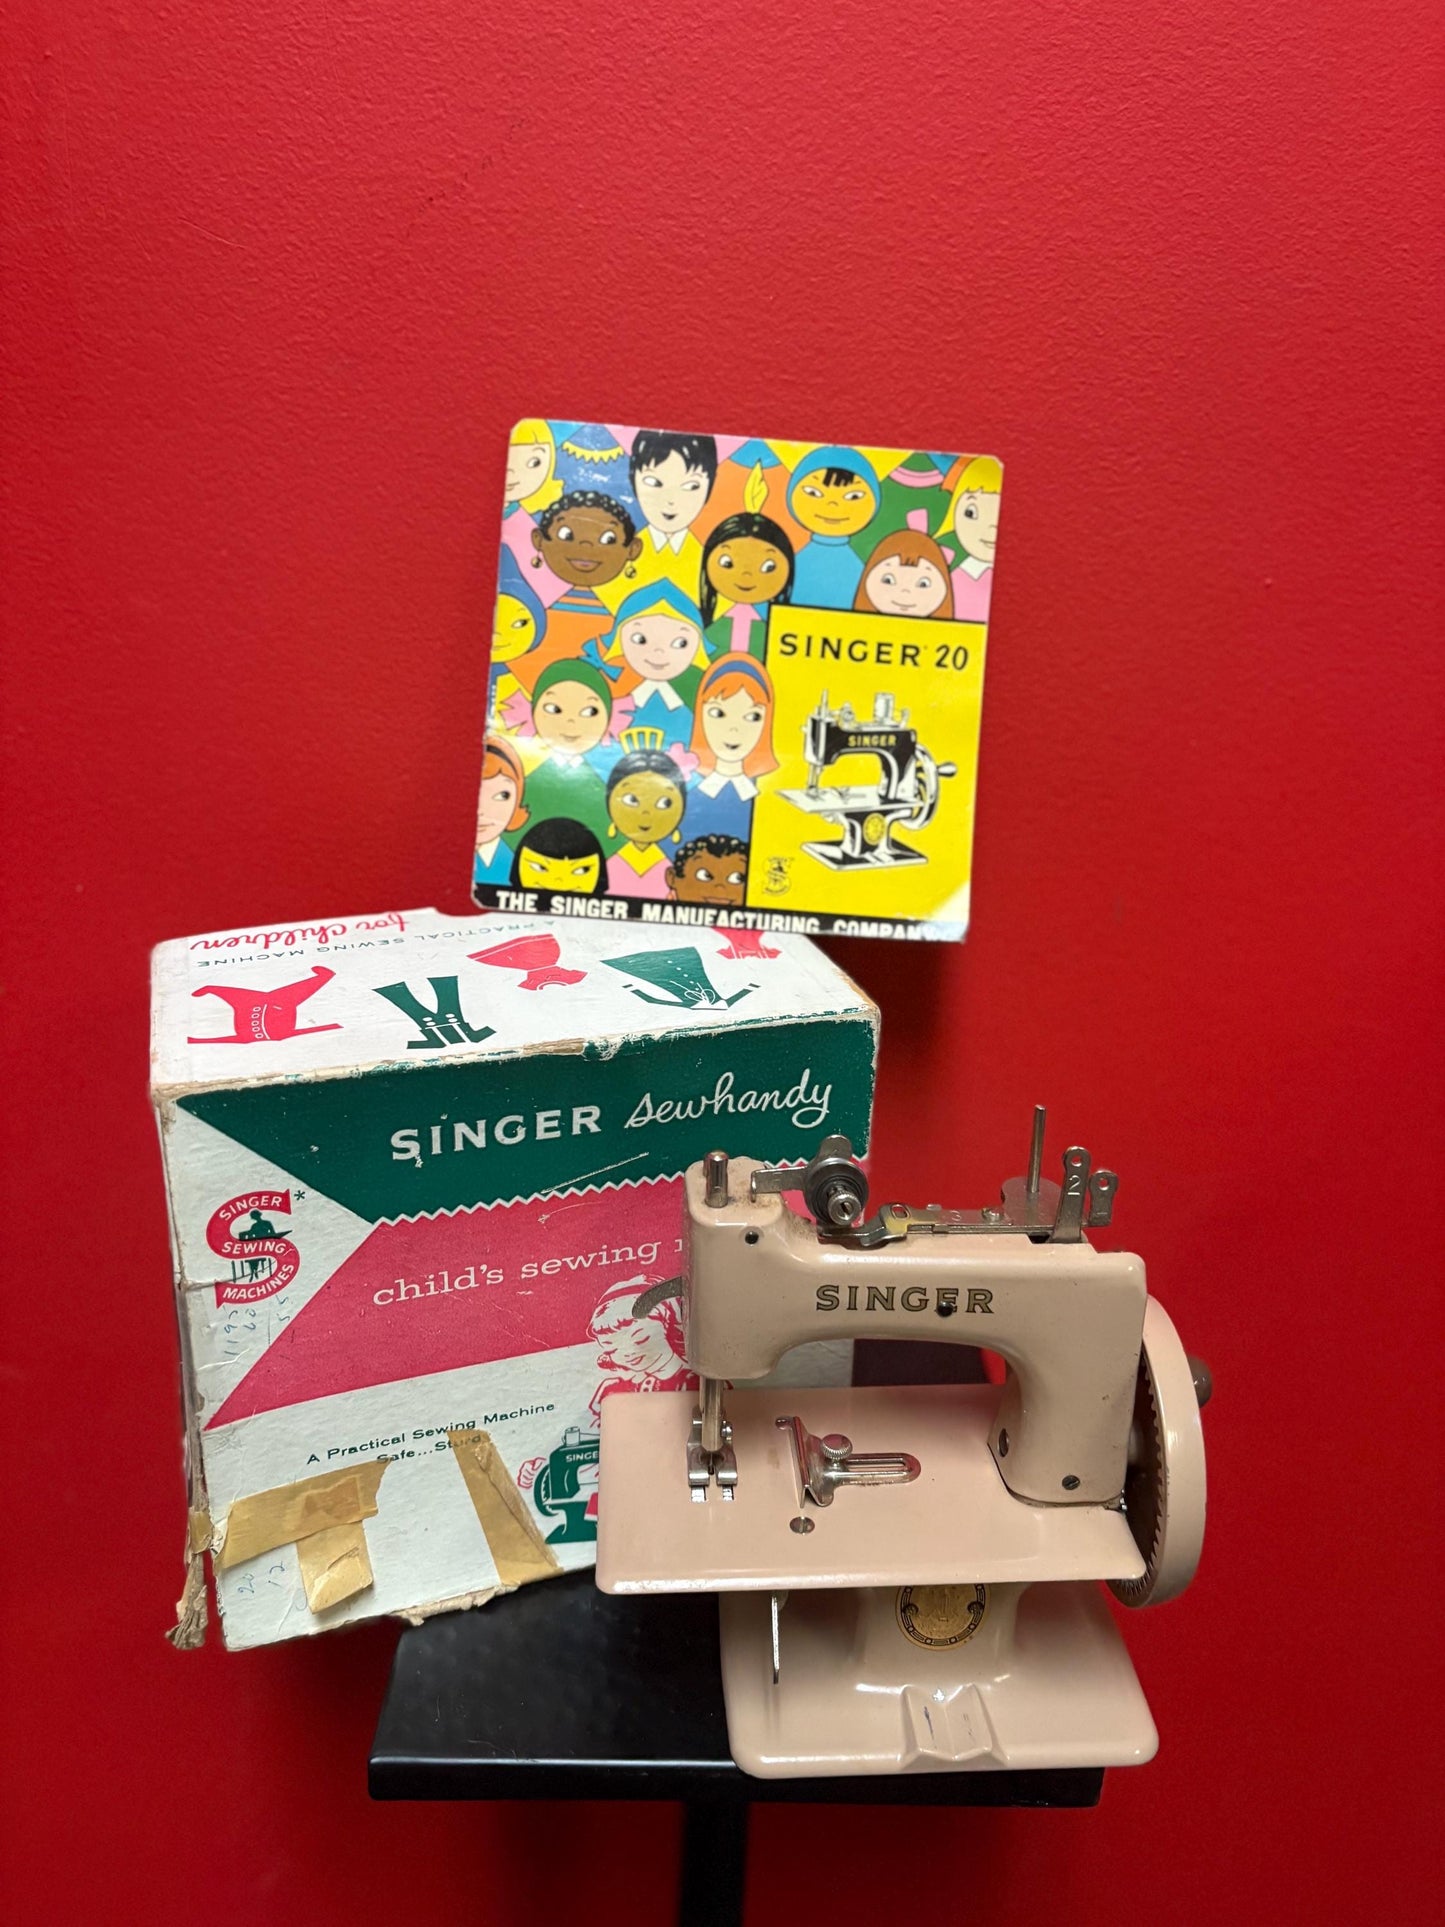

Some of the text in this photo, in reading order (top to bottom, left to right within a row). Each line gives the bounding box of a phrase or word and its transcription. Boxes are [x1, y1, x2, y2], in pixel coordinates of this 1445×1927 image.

[779, 633, 969, 671] SINGER 20
[848, 734, 897, 748] SINGER
[496, 889, 538, 913] THE
[549, 896, 629, 920] SINGER
[641, 903, 821, 934] MANUFACTURING
[190, 911, 411, 951] for children
[317, 936, 405, 953] SEWING
[419, 922, 535, 942] PRACTICAL
[197, 949, 305, 968] MACHINE
[389, 1104, 602, 1161] SINGER
[218, 1195, 283, 1222] SINGER
[221, 1240, 287, 1255] SEWING
[222, 1263, 295, 1300] MACHINES
[372, 1240, 662, 1306] child's sewing
[815, 1284, 995, 1314] SINGER
[306, 1402, 556, 1466] A Practical Sewing Machine
[565, 1450, 600, 1464] SINGE
